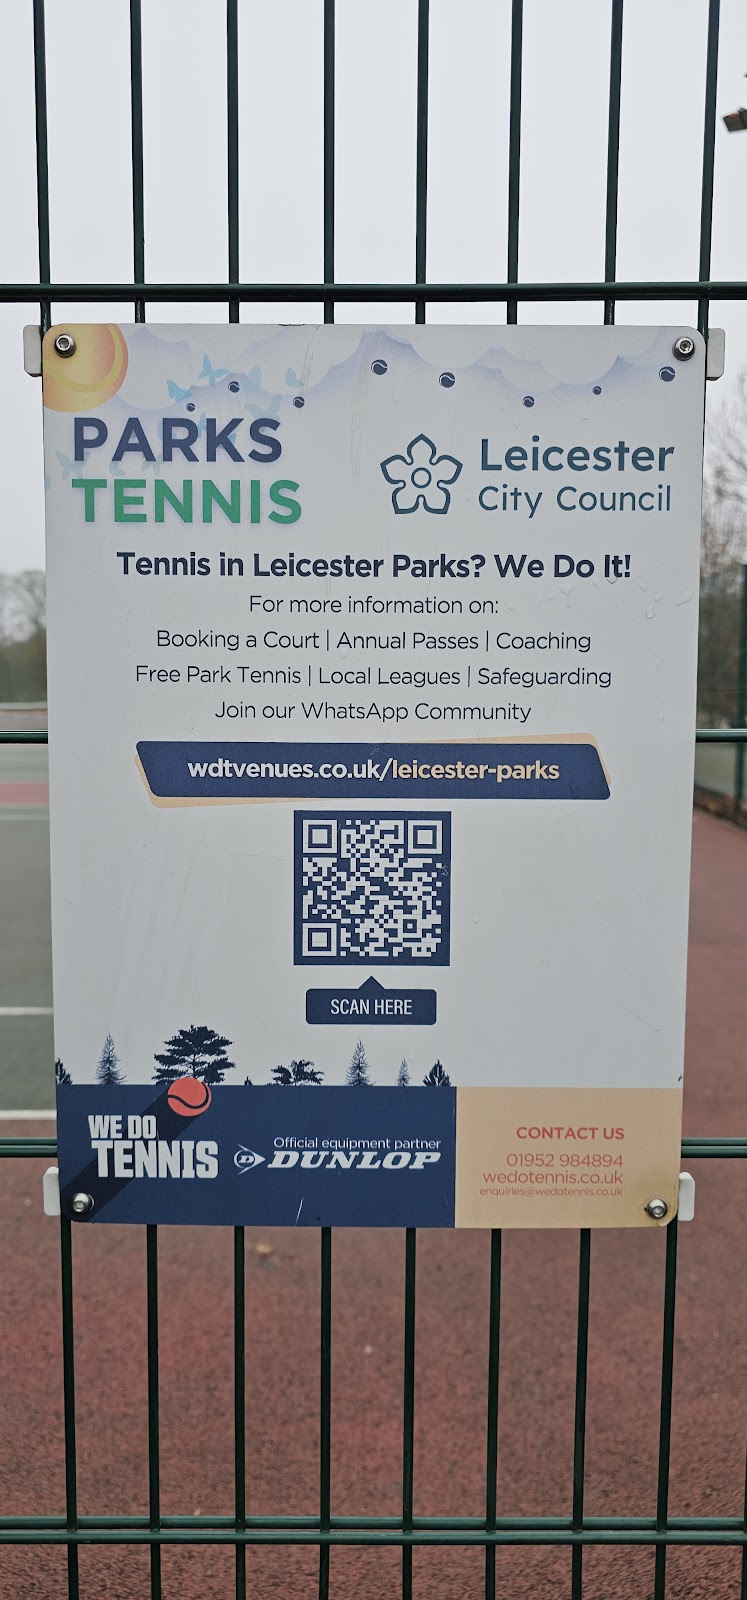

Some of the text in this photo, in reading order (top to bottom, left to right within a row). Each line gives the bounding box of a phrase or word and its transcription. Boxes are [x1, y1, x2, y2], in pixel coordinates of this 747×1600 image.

[73, 416, 283, 464] PARKS
[481, 434, 675, 472] Leicester
[71, 478, 302, 525] TENNIS
[478, 483, 671, 519] City Council
[117, 551, 631, 579] Tennis in Leicester Parks? We Do It!
[249, 595, 499, 614] For more information on:
[156, 629, 240, 651] Booking
[245, 634, 258, 649] a
[263, 630, 320, 650] Court
[336, 631, 406, 650] Annual
[412, 632, 479, 650] Passes
[496, 632, 591, 653] Coaching
[136, 665, 181, 683] Free
[187, 665, 232, 684] Park
[237, 666, 301, 684] Tennis
[319, 667, 371, 685] Local
[378, 667, 461, 688] Leagues
[477, 667, 612, 688] Safeguarding
[214, 701, 532, 723] Join our WhatsApp Community
[187, 757, 560, 783] wdtvenues.co.uk/leicester-parks
[330, 998, 413, 1015] SCAN HERE
[87, 1114, 157, 1140] WE DO
[516, 1126, 625, 1140] CONTACT US
[273, 1136, 442, 1151] Official equipment partner
[91, 1139, 219, 1179] TENNIS
[266, 1150, 442, 1170] DUNLOP
[506, 1152, 624, 1168] 01952 984894
[482, 1170, 624, 1185] wedotennis.co.uk
[479, 1186, 623, 1197] enquiries@wedotennis.co.uk
